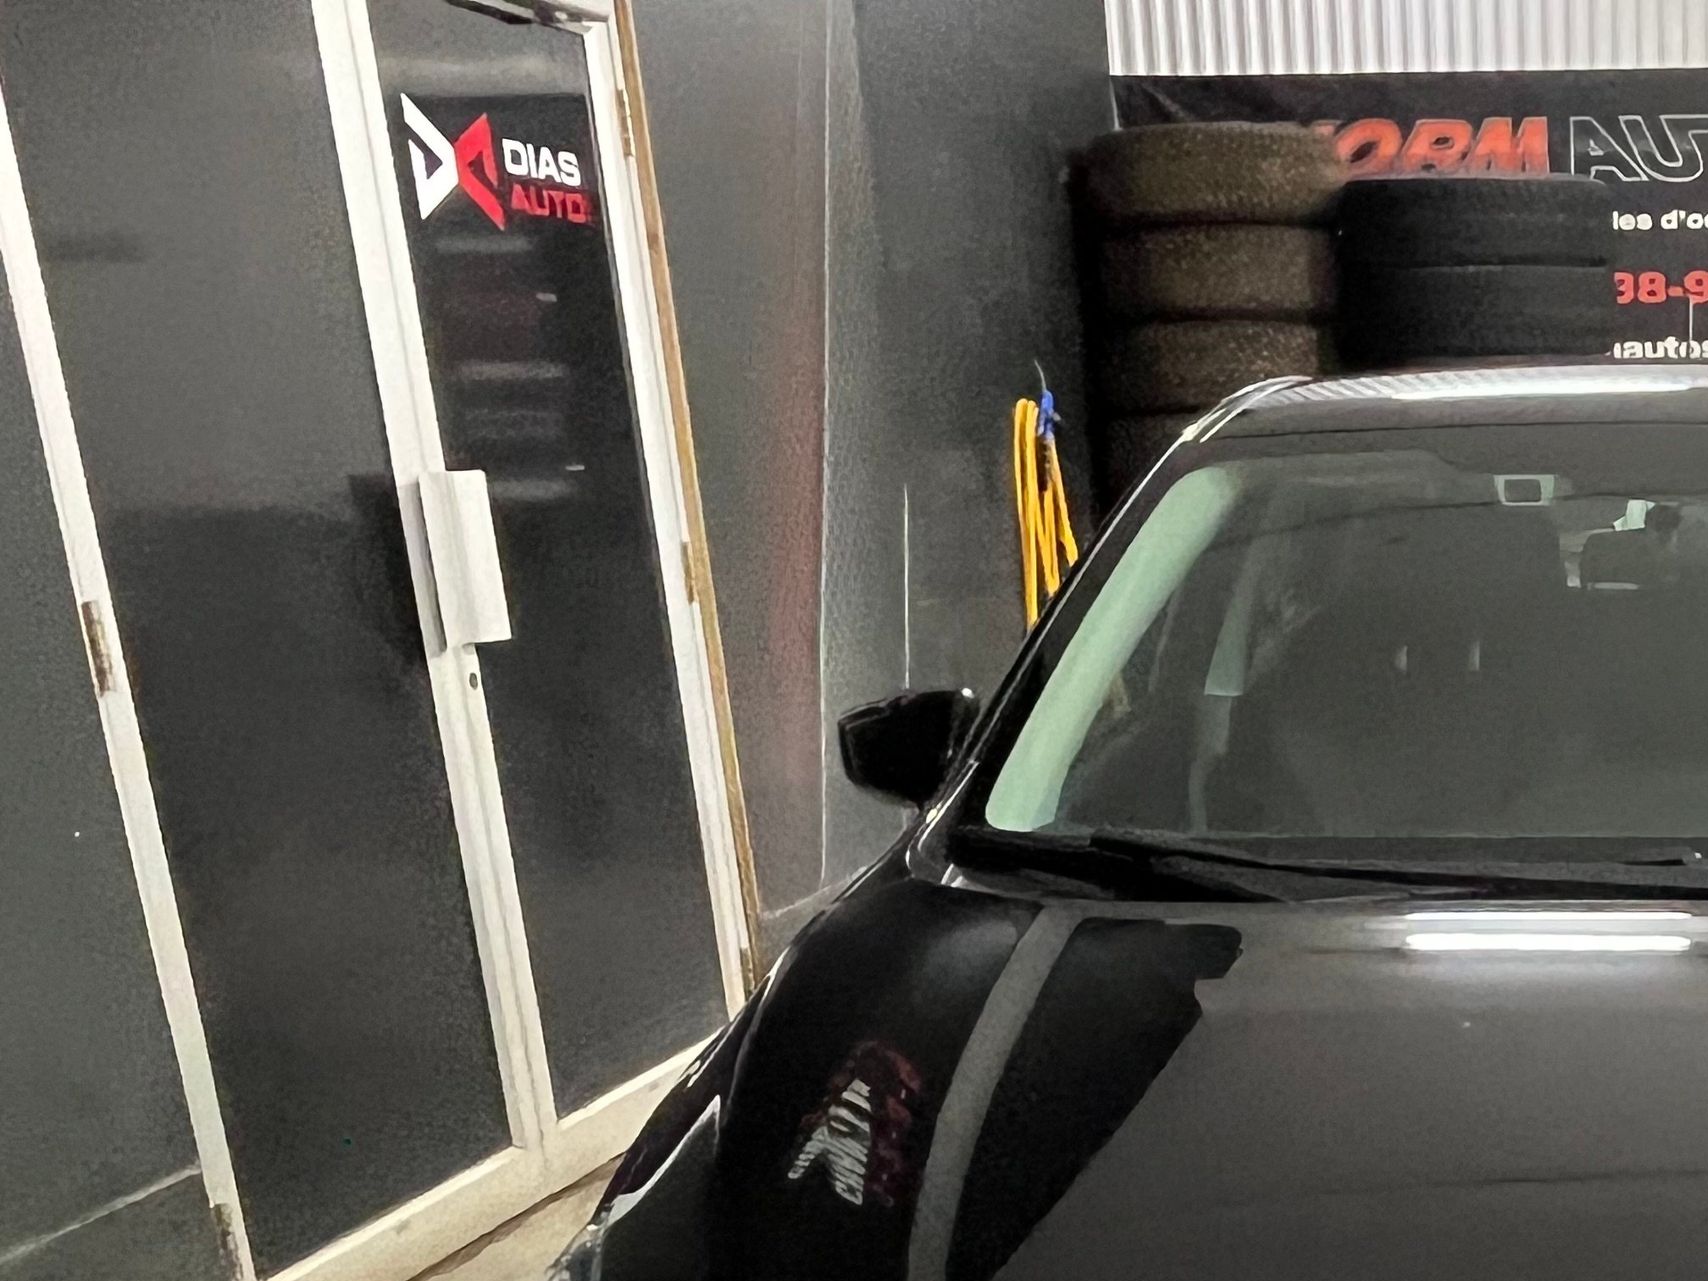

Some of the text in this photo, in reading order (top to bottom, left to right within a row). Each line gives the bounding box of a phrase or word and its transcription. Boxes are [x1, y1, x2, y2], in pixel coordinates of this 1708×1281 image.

[502, 138, 581, 187] DIAS
[1311, 117, 1550, 179] ORM
[511, 183, 588, 224] AUTO
